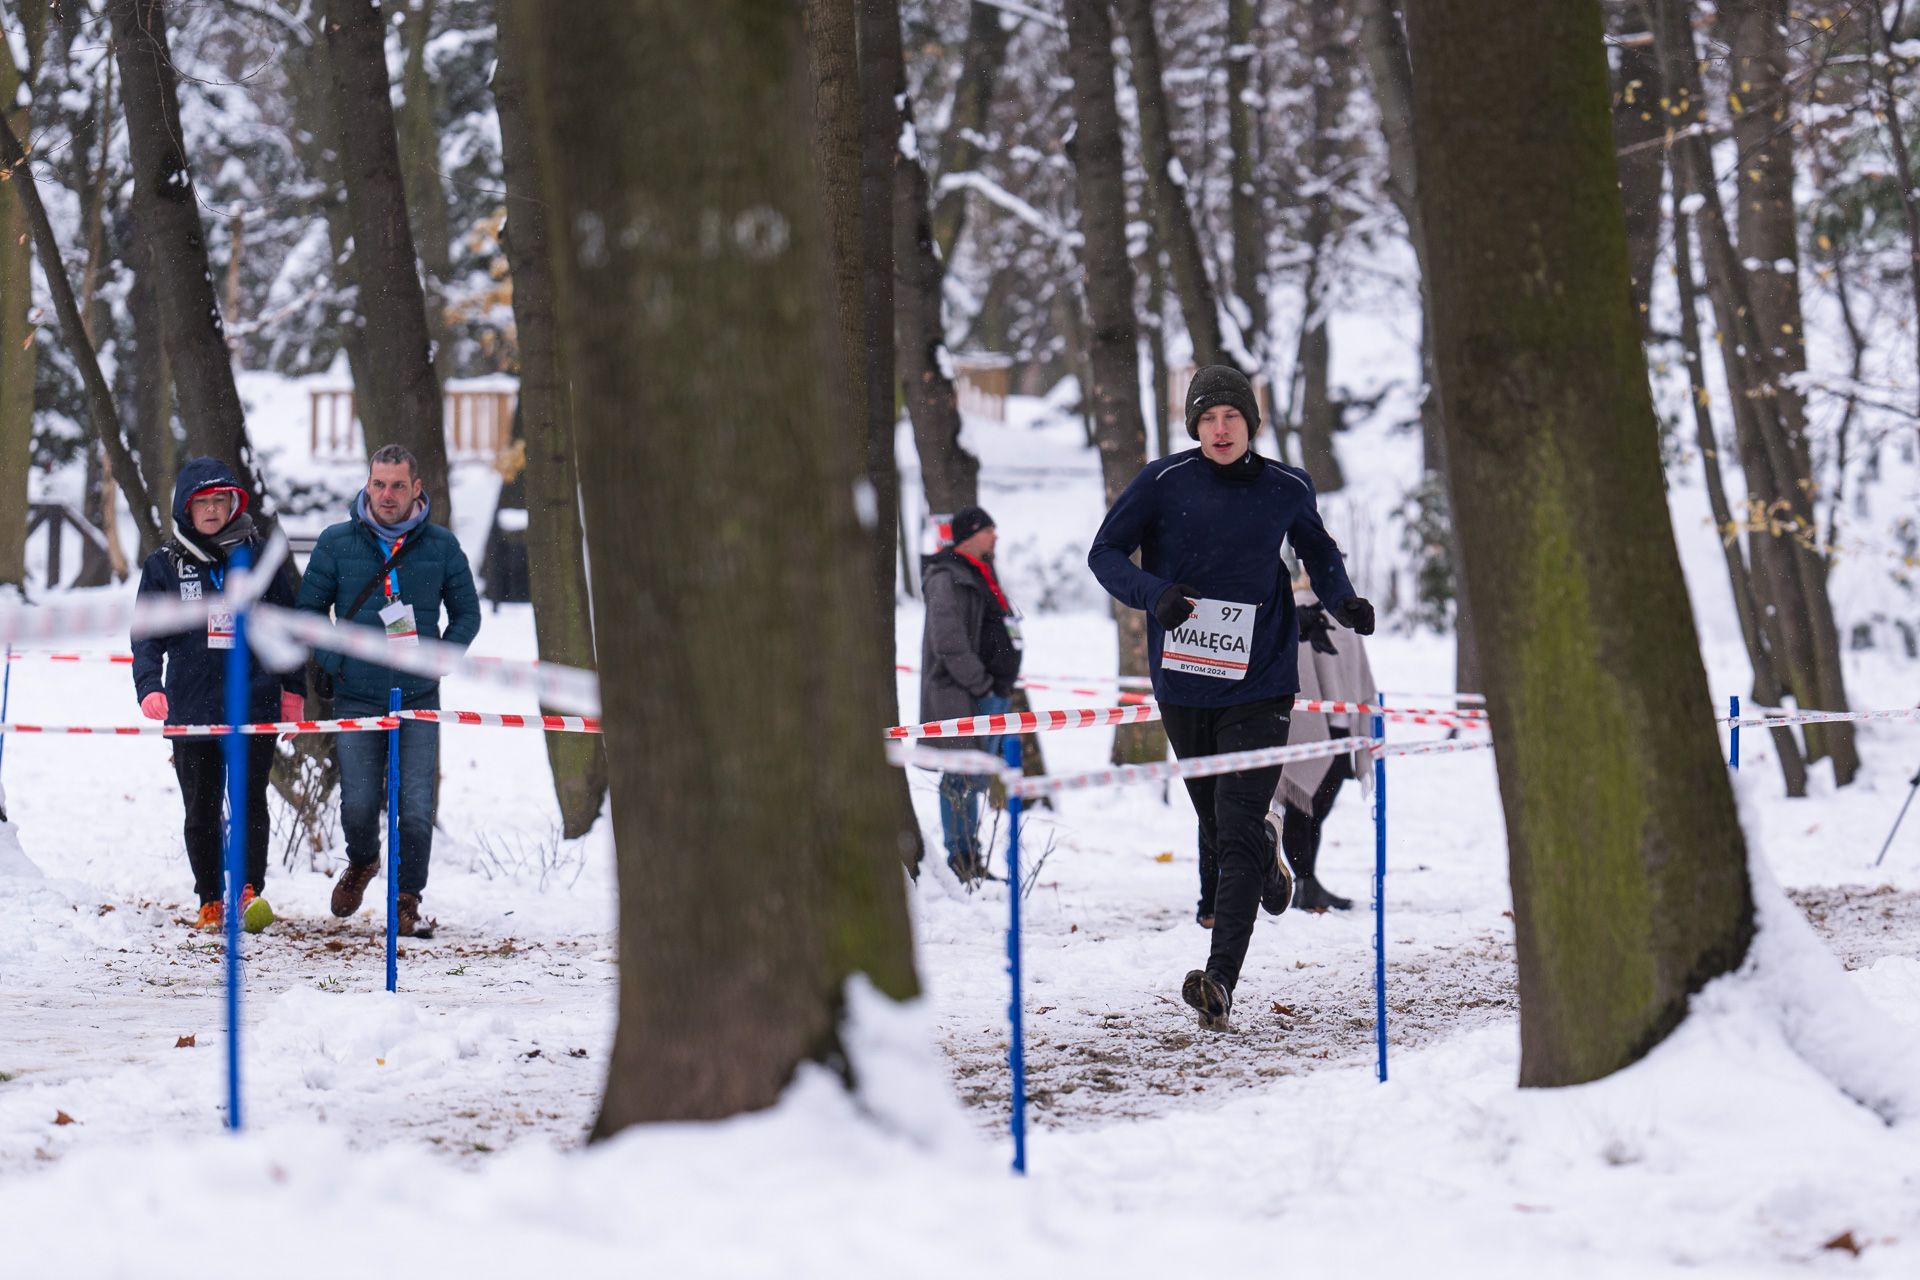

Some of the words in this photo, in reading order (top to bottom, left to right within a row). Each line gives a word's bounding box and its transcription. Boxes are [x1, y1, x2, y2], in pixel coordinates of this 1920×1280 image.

[1221, 606, 1243, 622] 97
[1171, 627, 1246, 653] WAŁĘGA
[1180, 663, 1206, 673] BYTOM
[1207, 667, 1226, 676] 2024
